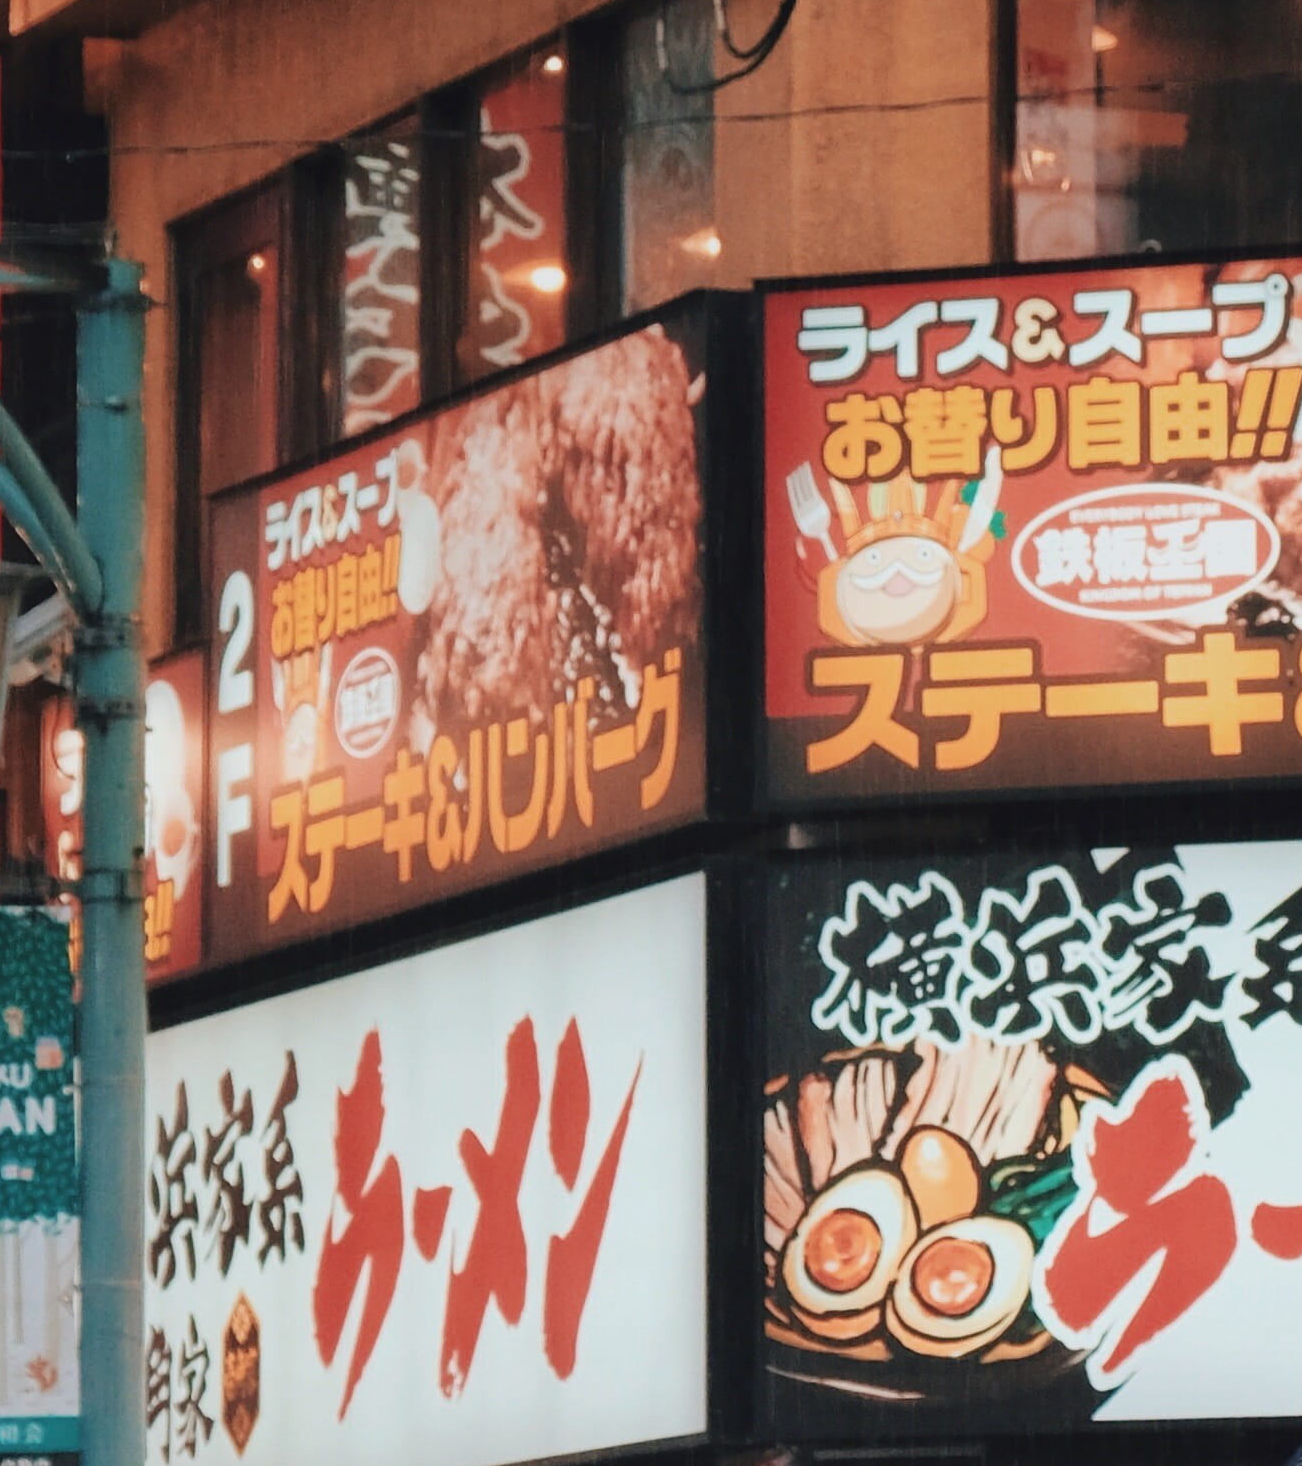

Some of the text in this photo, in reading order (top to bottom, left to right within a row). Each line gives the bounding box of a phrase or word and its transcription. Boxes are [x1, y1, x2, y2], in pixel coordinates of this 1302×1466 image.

[797, 273, 1294, 383] ライス&スープ
[268, 647, 683, 925] ステーキ&ハンバーグ
[312, 1013, 645, 1423] ラーメン
